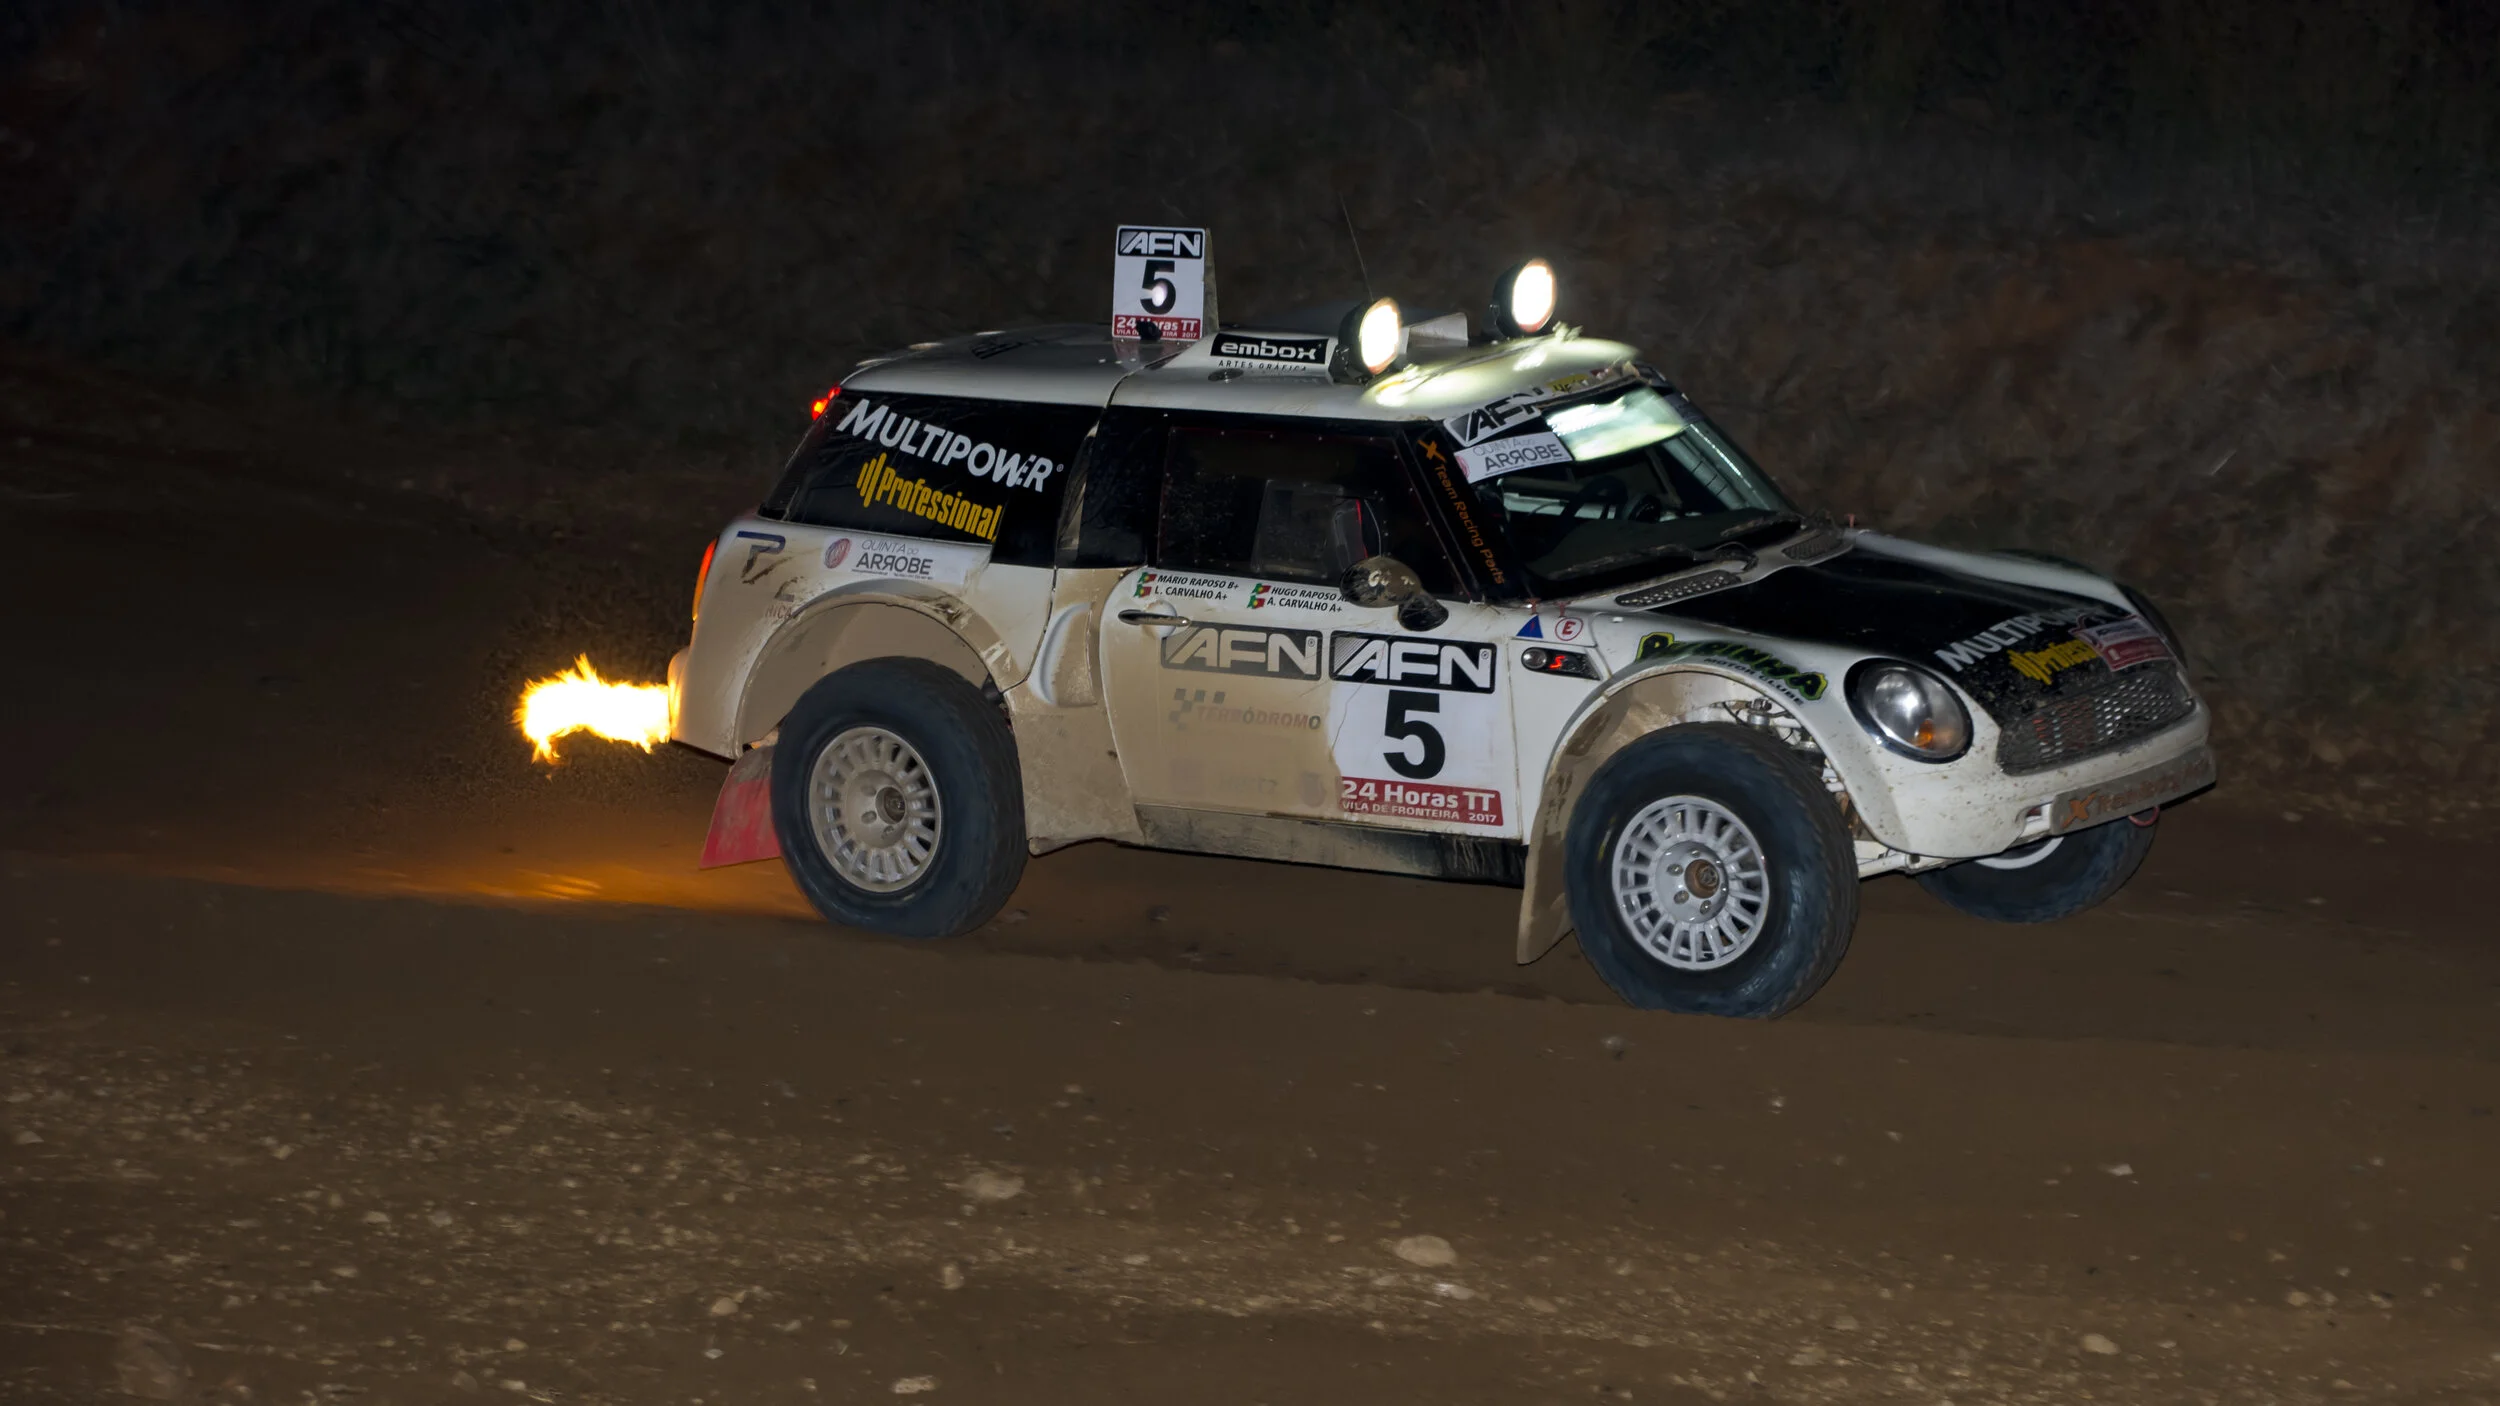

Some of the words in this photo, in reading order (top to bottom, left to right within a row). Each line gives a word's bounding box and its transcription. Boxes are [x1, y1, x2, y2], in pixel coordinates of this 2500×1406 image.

[1120, 231, 1200, 256] AFN
[1139, 259, 1177, 315] 5
[1117, 317, 1138, 330] 24
[1181, 320, 1198, 332] TT
[1220, 340, 1318, 361] embox
[1218, 360, 1253, 369] ARTES
[836, 398, 1054, 493] MULTIPOWER
[875, 466, 1003, 543] Professional
[1433, 463, 1460, 501] Team
[1453, 500, 1485, 548] Racing
[1479, 547, 1506, 585] Parts
[861, 538, 907, 554] QUINTA
[1154, 586, 1164, 596] L.
[1165, 588, 1214, 600] CARVALHO
[1215, 591, 1228, 601] A+
[1189, 577, 1227, 589] RAPOSO
[1227, 580, 1240, 590] B+
[1270, 586, 1298, 598] HUGO
[1299, 589, 1338, 602] RAPOSO
[1266, 596, 1277, 606] A.
[1278, 598, 1328, 612] CARVALHO
[1329, 602, 1343, 613] A+
[1562, 620, 1576, 635] E
[1167, 627, 1319, 676] AFN
[1334, 634, 1493, 688] AFN
[1550, 655, 1566, 669] S
[1703, 657, 1756, 676] MOTOR
[1758, 674, 1805, 706] CLUBE
[1383, 689, 1446, 780] 5
[1341, 780, 1378, 801] 24
[1384, 783, 1459, 809] Horas
[1462, 791, 1496, 812] TT
[1342, 800, 1369, 813] VILA
[1372, 803, 1389, 813] DE
[1391, 805, 1460, 820] FRONTEIRA
[1468, 812, 1498, 824] 2017
